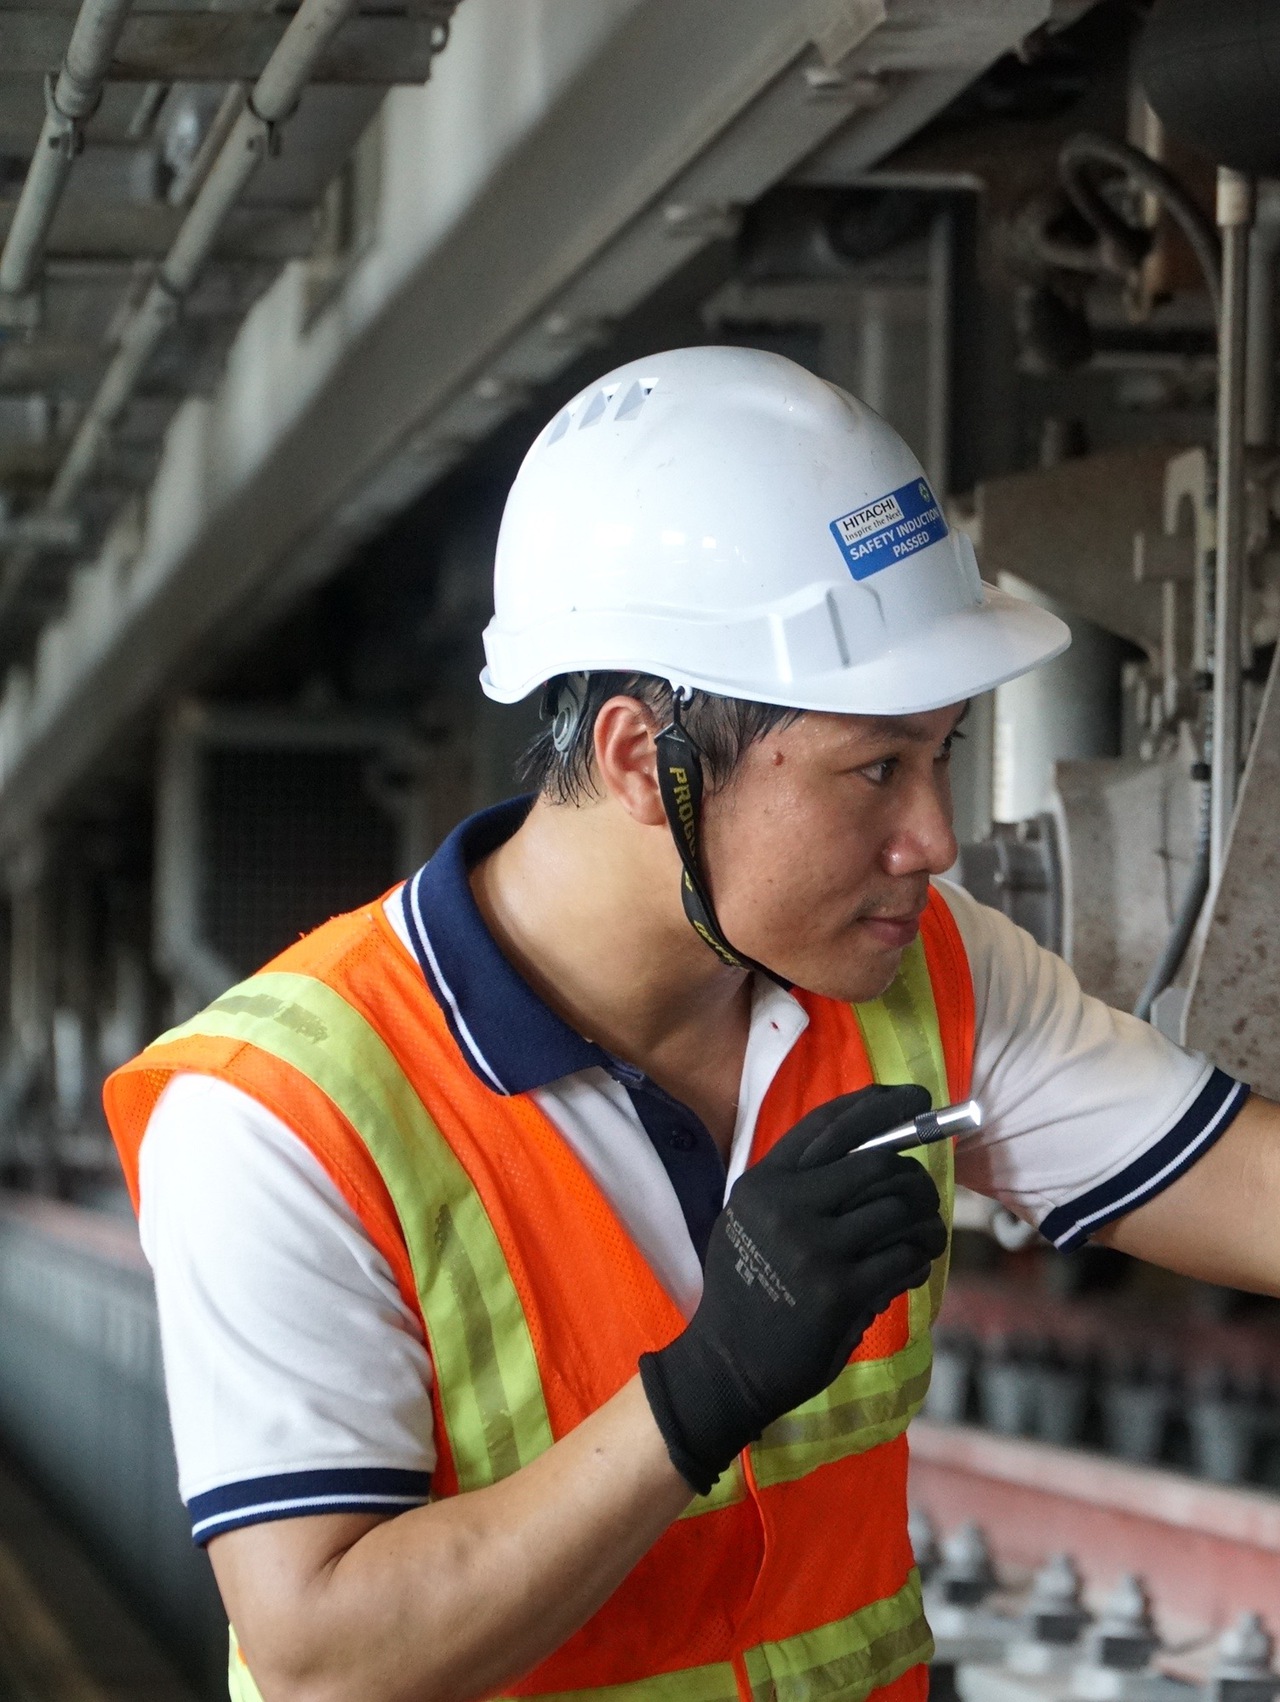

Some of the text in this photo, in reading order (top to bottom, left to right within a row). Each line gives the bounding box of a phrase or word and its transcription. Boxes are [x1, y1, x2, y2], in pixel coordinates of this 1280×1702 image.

[842, 499, 895, 531] HITACHI
[845, 509, 902, 542] Inspire the Next
[849, 508, 939, 561] SAFETY INDUCTION
[892, 531, 930, 558] PASSED
